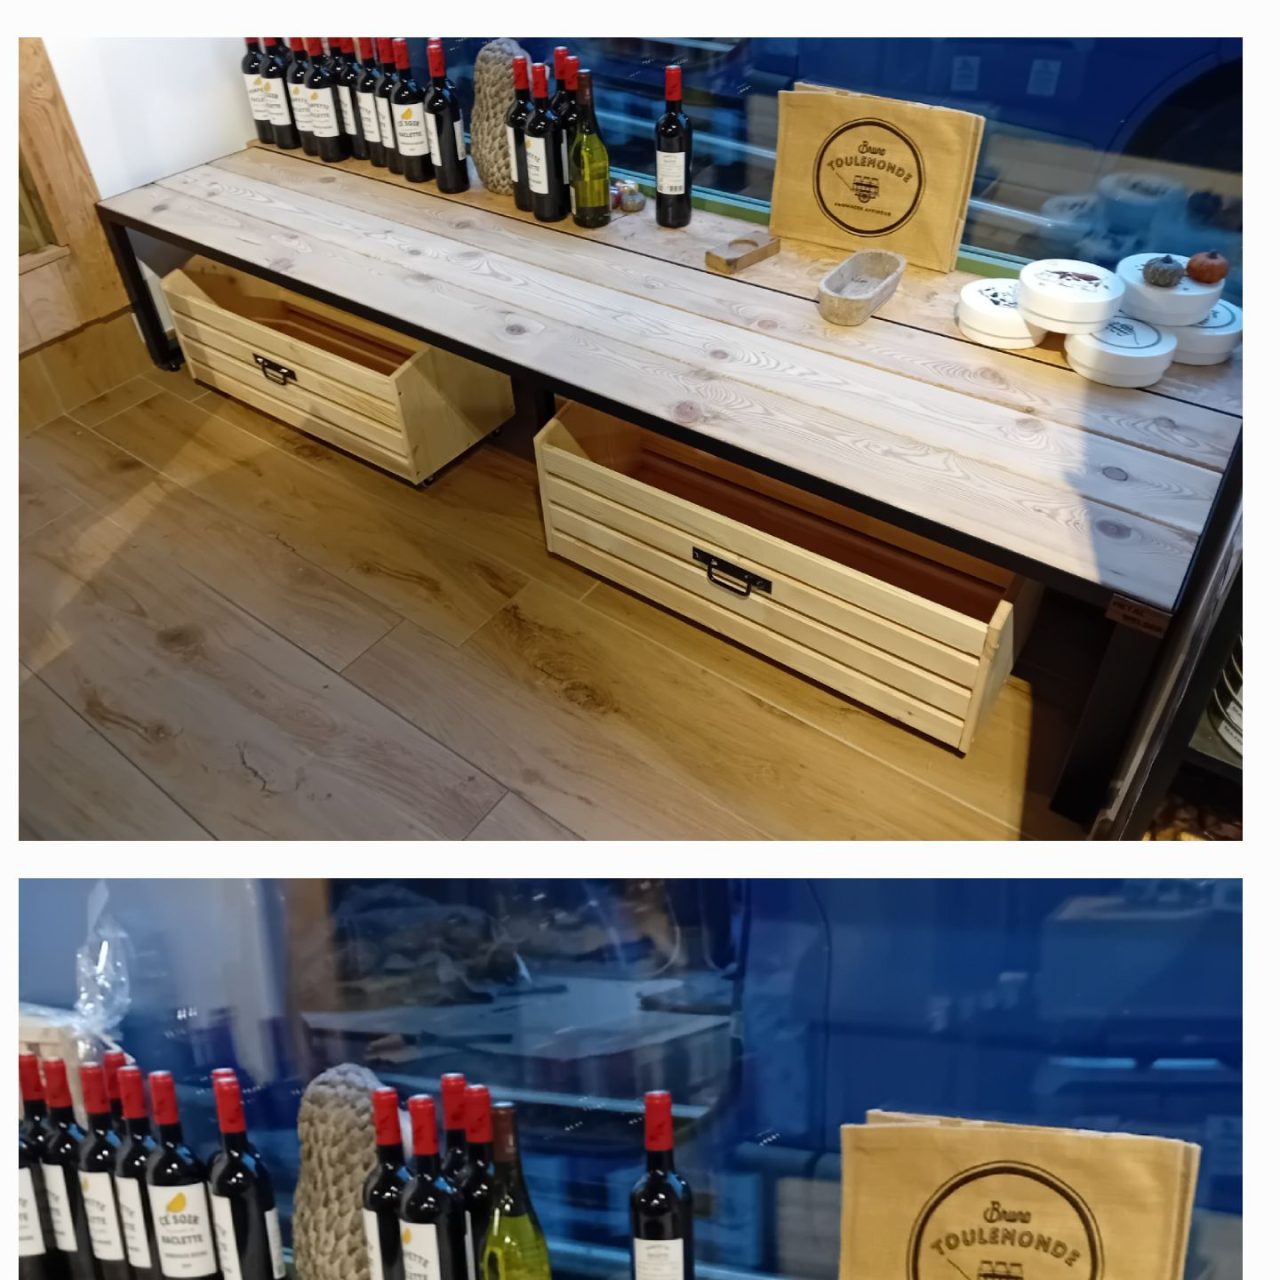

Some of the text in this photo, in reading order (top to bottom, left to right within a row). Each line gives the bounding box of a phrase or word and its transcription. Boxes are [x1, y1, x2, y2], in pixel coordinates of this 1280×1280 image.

[857, 140, 886, 156] Bruno
[826, 155, 913, 183] TOULEMONDE
[983, 1200, 1032, 1224] Bruno
[930, 1226, 1081, 1267] TOULEMONDE
